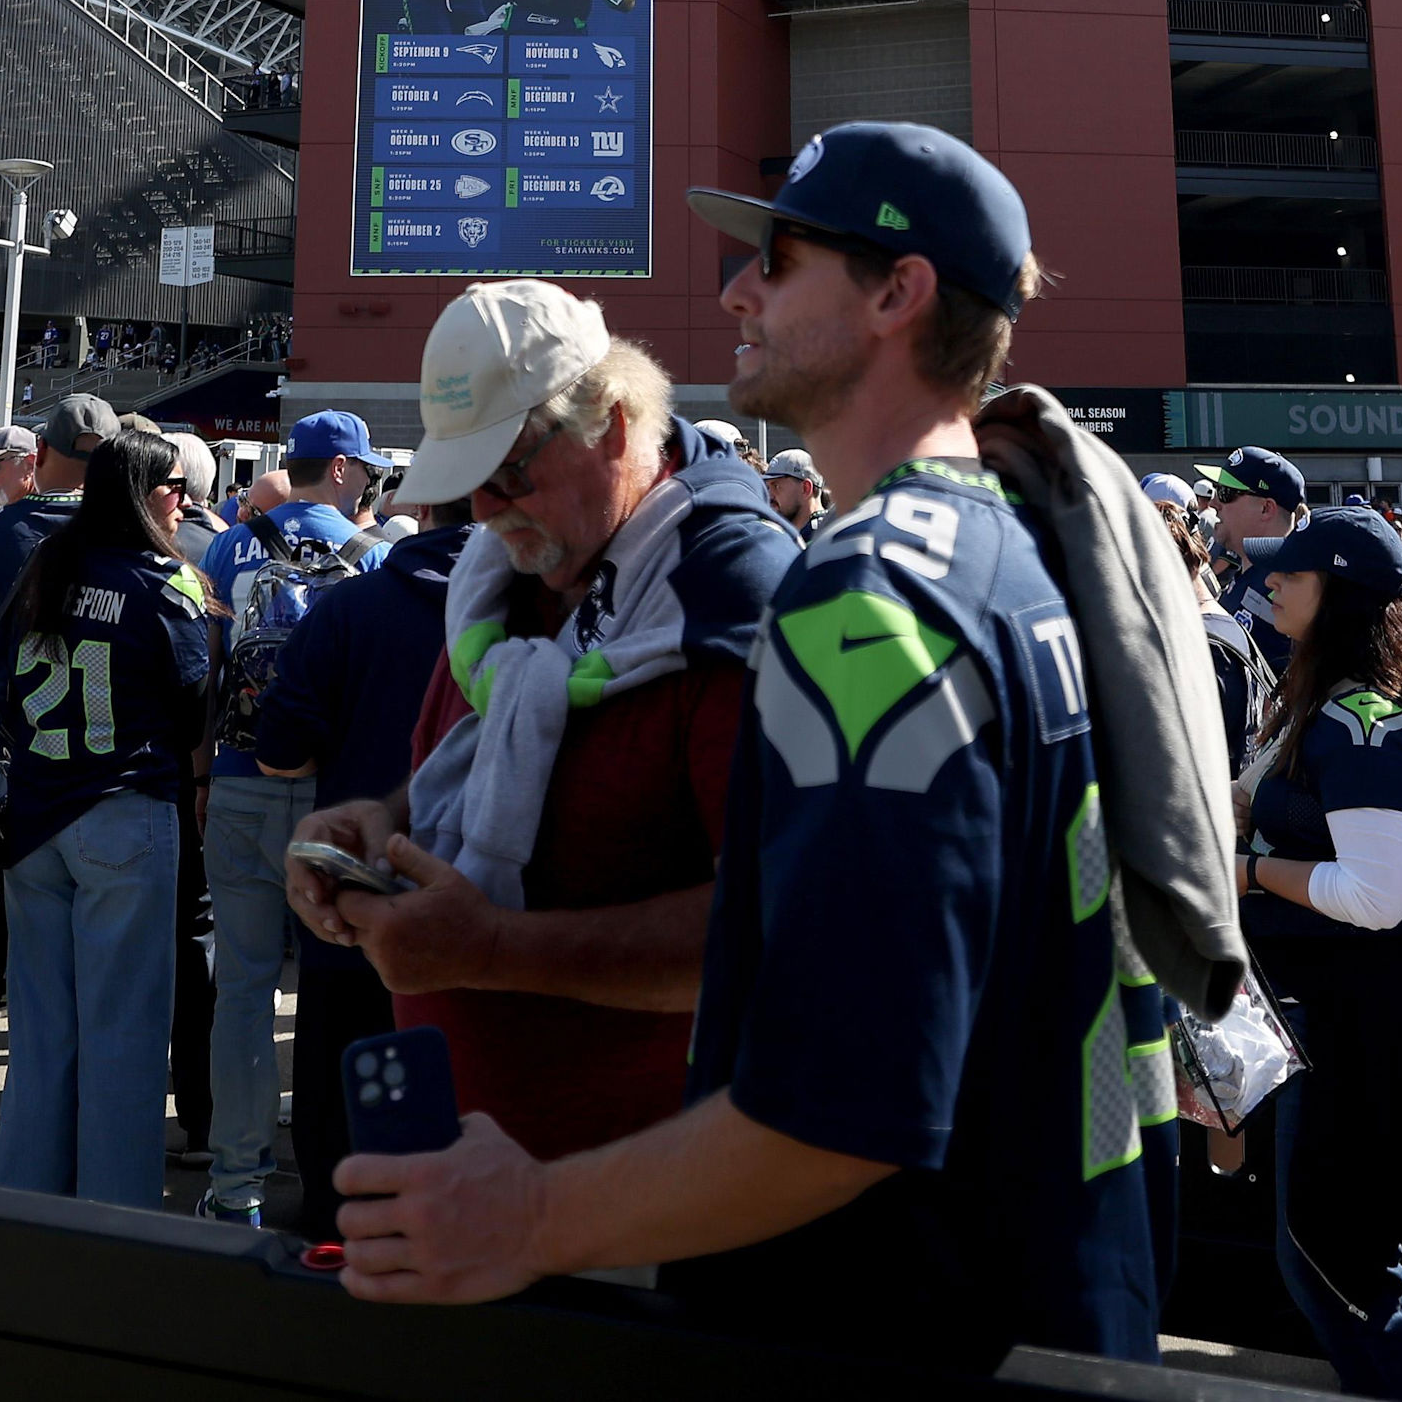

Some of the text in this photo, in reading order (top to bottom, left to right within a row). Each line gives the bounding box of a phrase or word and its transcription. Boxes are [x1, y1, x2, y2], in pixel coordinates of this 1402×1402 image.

[393, 46, 449, 57] SEPTEMBER 9
[526, 48, 579, 59] NOVEMBER 8
[391, 90, 439, 101] OCTOBER 4
[524, 91, 575, 103] DECEMBER 7
[390, 134, 440, 146] OCTOBER 11
[524, 136, 579, 147] DECEMBER 13
[388, 179, 442, 190] OCTOBER 25
[523, 180, 581, 191] DECEMBER 25
[387, 225, 441, 236] NOVEMBER 2
[540, 238, 634, 247] FOR TICKETS VISIT
[555, 246, 635, 255] SEAHAWKS.COM
[1088, 407, 1126, 419] SEASON
[214, 418, 234, 431] WE
[236, 419, 261, 433] ARE
[14, 631, 117, 761] 21
